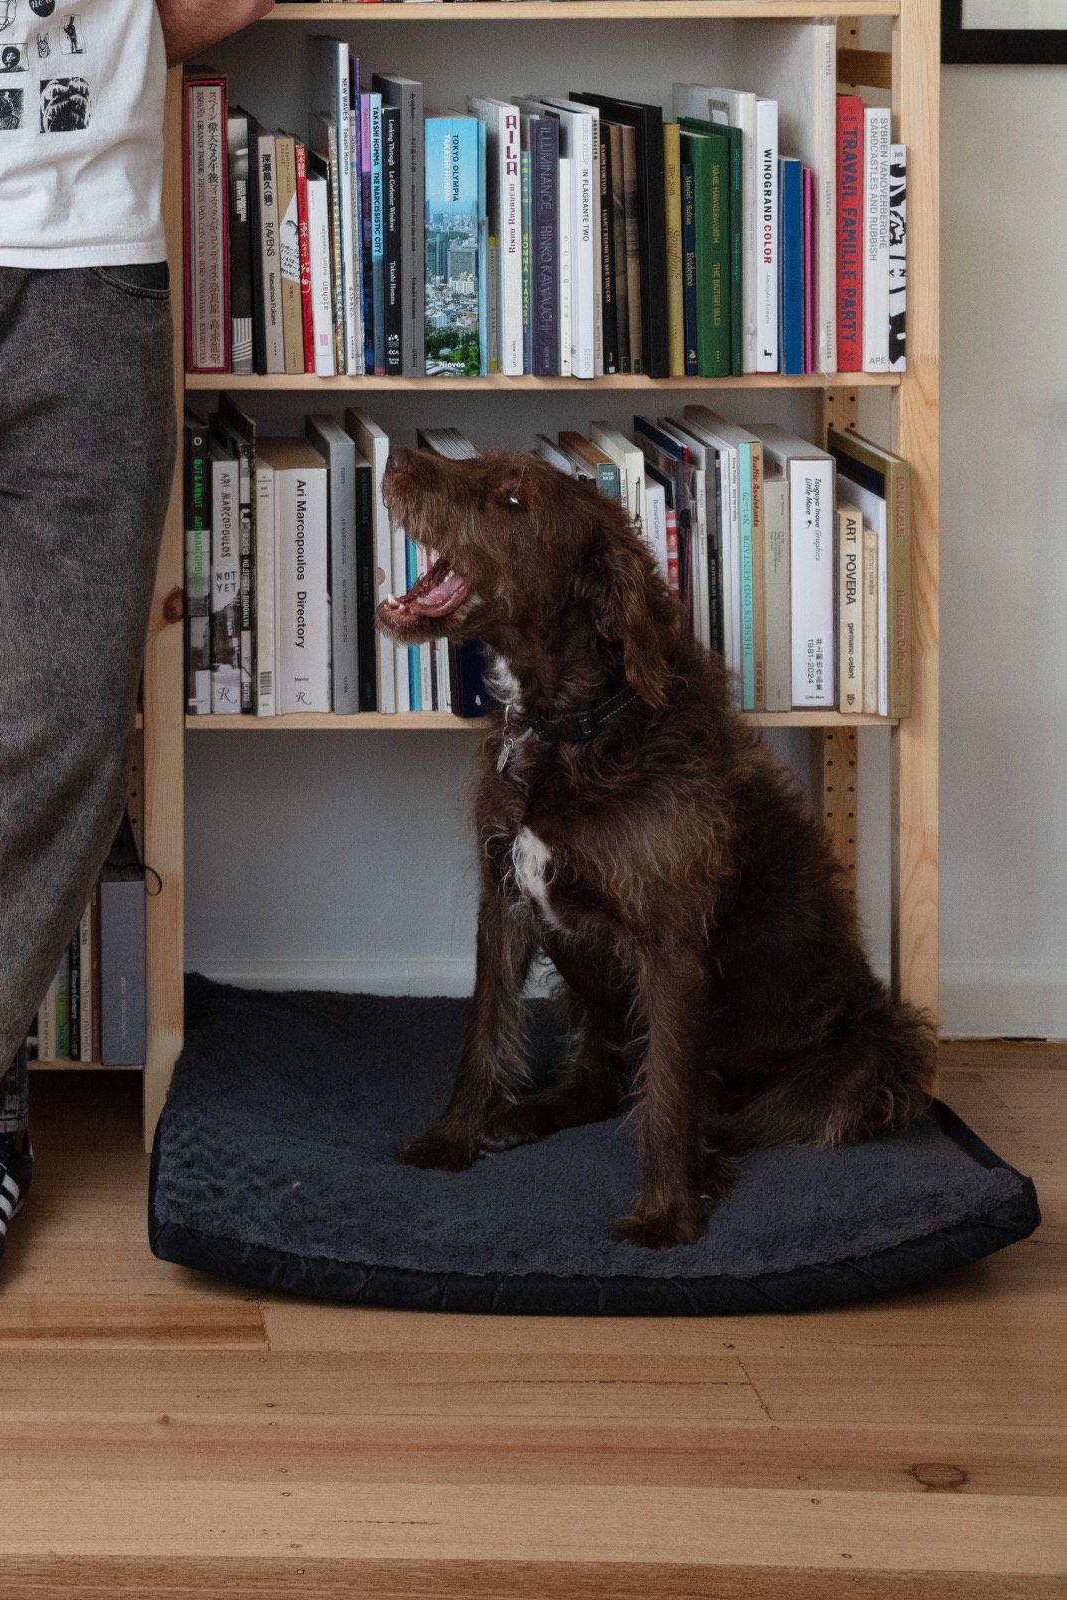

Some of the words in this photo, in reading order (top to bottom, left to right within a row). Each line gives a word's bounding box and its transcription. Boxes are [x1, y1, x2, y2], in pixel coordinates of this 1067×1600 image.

[373, 106, 381, 137] TAKASHI
[880, 118, 888, 158] SYBREN
[373, 138, 381, 166] HOMMA
[452, 134, 460, 163] TOKYO
[842, 127, 858, 200] TRAVAIL
[870, 118, 879, 193] SANDCASTLES
[373, 172, 381, 186] THE
[452, 165, 460, 202] OLYMPIA
[582, 169, 589, 177] IN
[763, 149, 772, 222] WINOGRAND
[373, 187, 381, 236] NARCISSISTIC
[870, 194, 878, 214] AND
[879, 160, 888, 249] VANOVERBERGHE
[266, 222, 275, 256] RAVENS
[374, 237, 382, 253] CITY
[582, 225, 590, 242] TWO
[764, 225, 772, 264] COLOR
[841, 207, 857, 280] FAMILLE
[870, 217, 878, 261] RUBBISH
[841, 288, 855, 343] PARTY
[222, 473, 230, 487] ARI
[296, 479, 306, 497] Ari
[813, 478, 822, 506] Tsuguya
[221, 493, 231, 558] MARCOPOULOS
[295, 501, 306, 581] Marcopoulos
[846, 518, 856, 543] ART
[813, 529, 822, 561] Graphics
[217, 572, 237, 581] NOT
[217, 584, 237, 593] YET
[846, 554, 856, 605] POVERA
[295, 591, 307, 648] Directory
